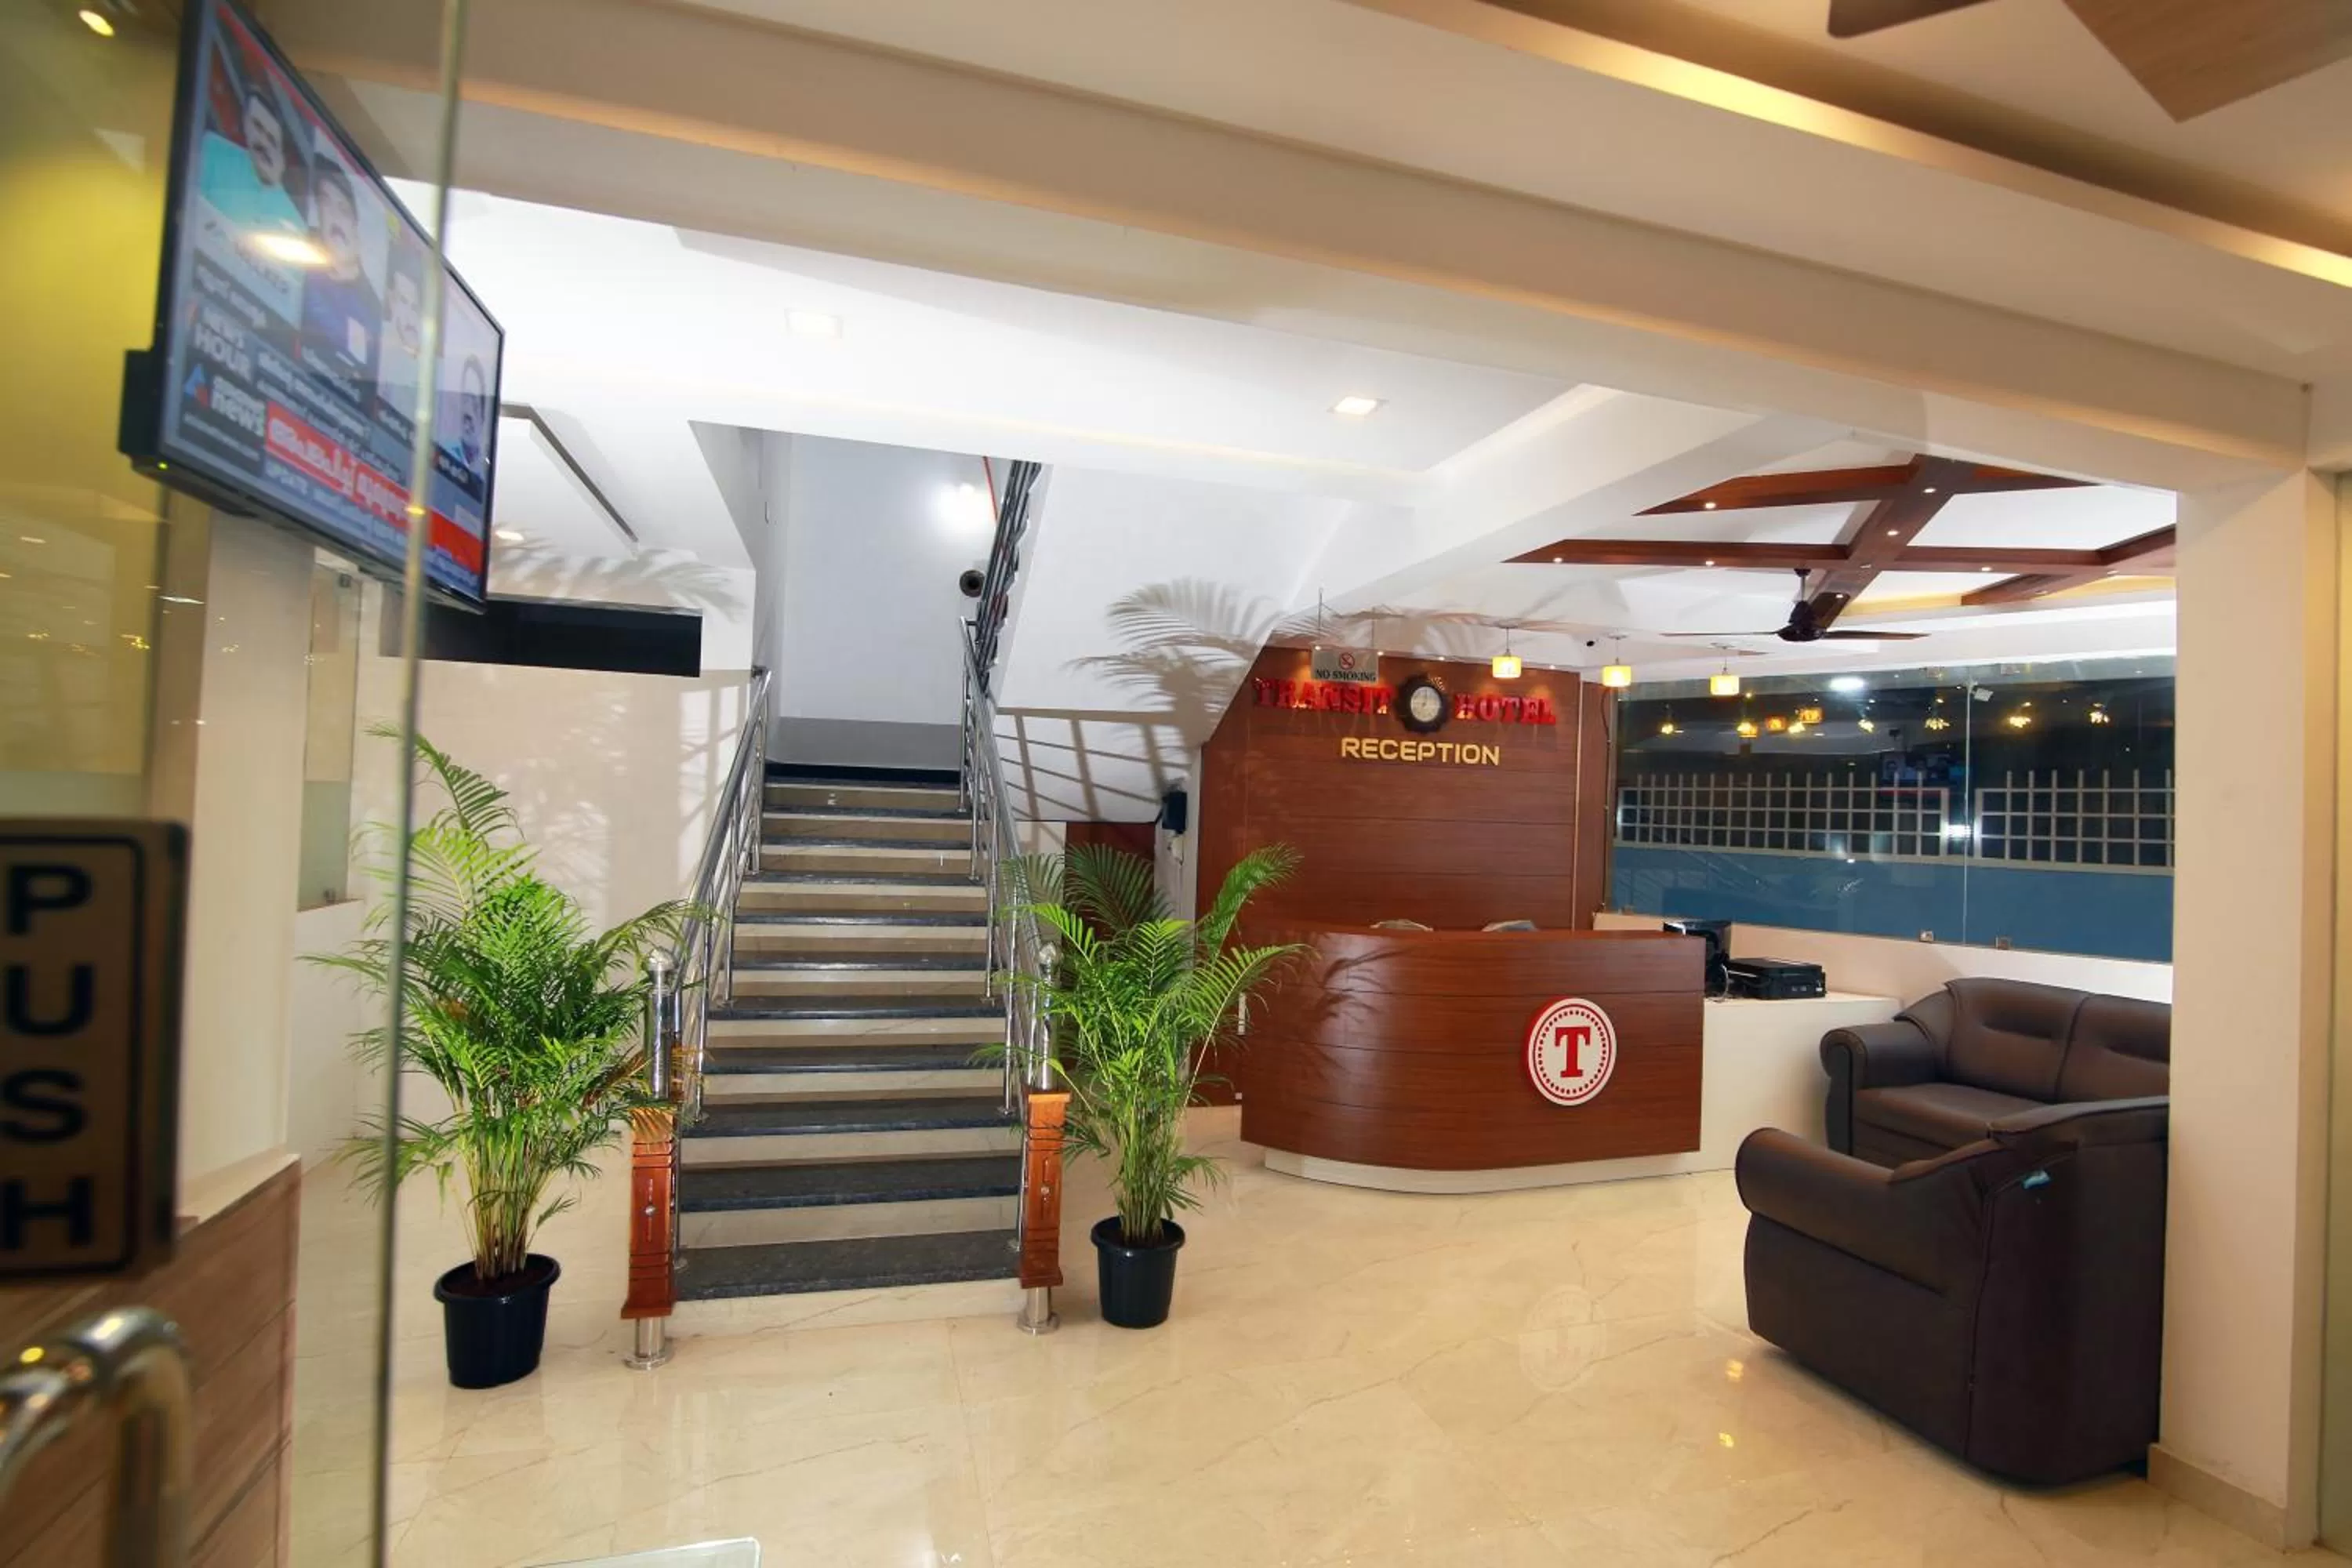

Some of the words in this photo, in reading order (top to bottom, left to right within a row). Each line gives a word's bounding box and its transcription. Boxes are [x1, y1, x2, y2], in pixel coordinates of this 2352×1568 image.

[194, 322, 253, 385] HOUR
[1316, 669, 1330, 680] NO
[1333, 670, 1377, 682] SMOKING
[1455, 692, 1556, 726] HOTEL
[1341, 736, 1501, 766] RECEPTION
[2, 866, 94, 1250] PUSH
[1555, 1026, 1591, 1078] T
